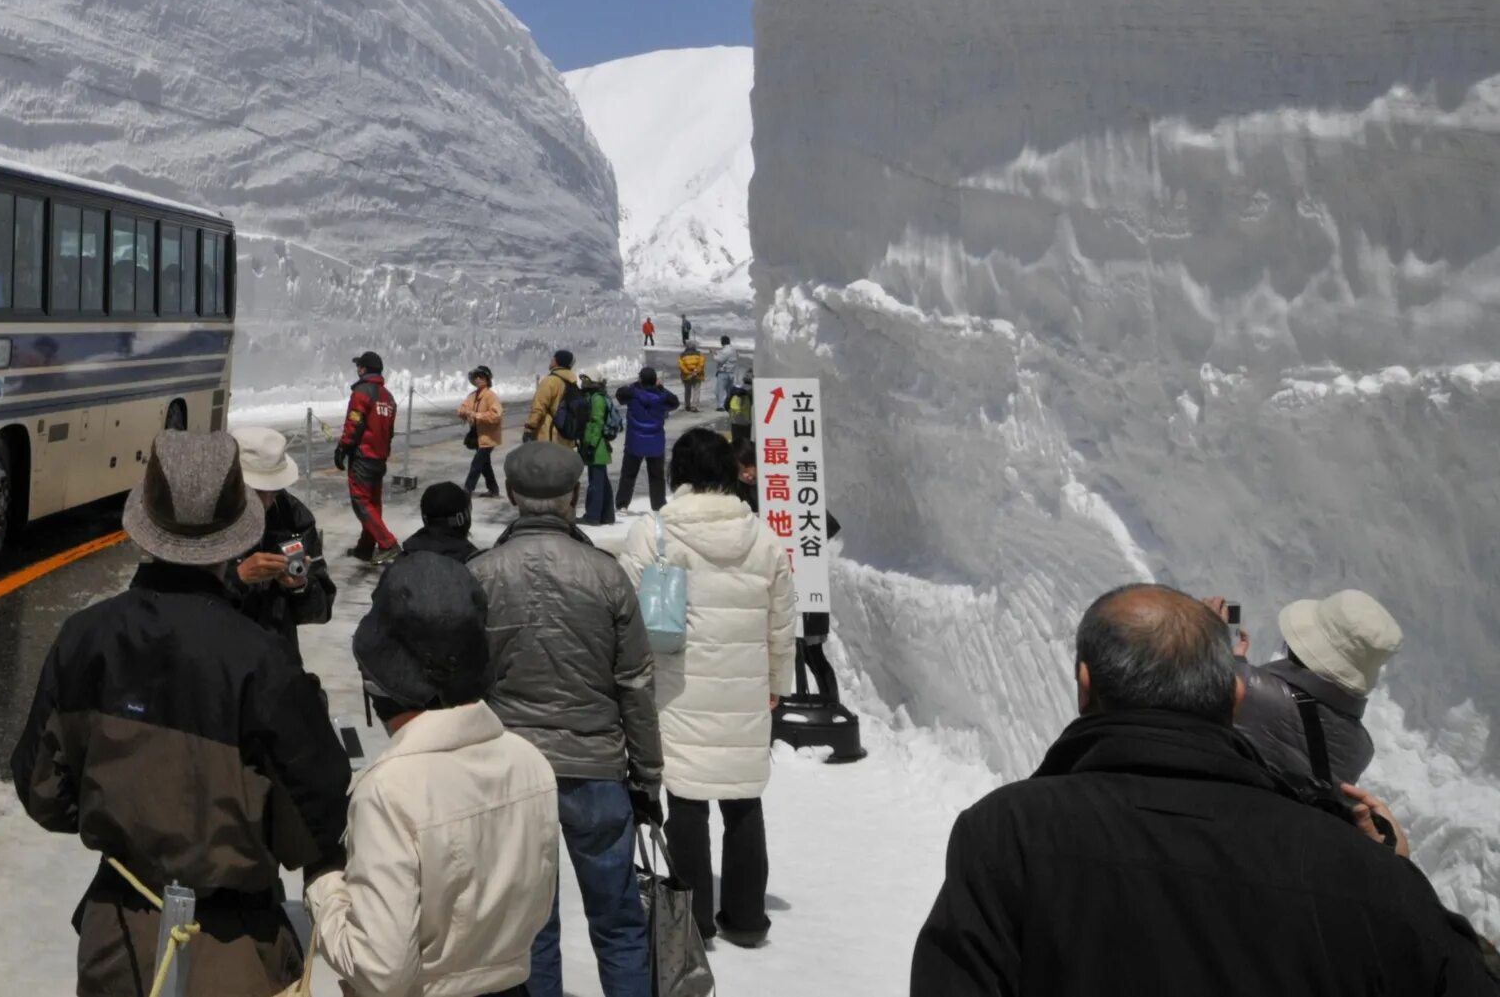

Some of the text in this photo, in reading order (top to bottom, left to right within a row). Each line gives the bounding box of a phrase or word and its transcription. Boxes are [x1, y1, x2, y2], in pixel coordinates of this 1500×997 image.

[791, 390, 822, 557] 立山・雪の大谷
[810, 591, 823, 603] m
